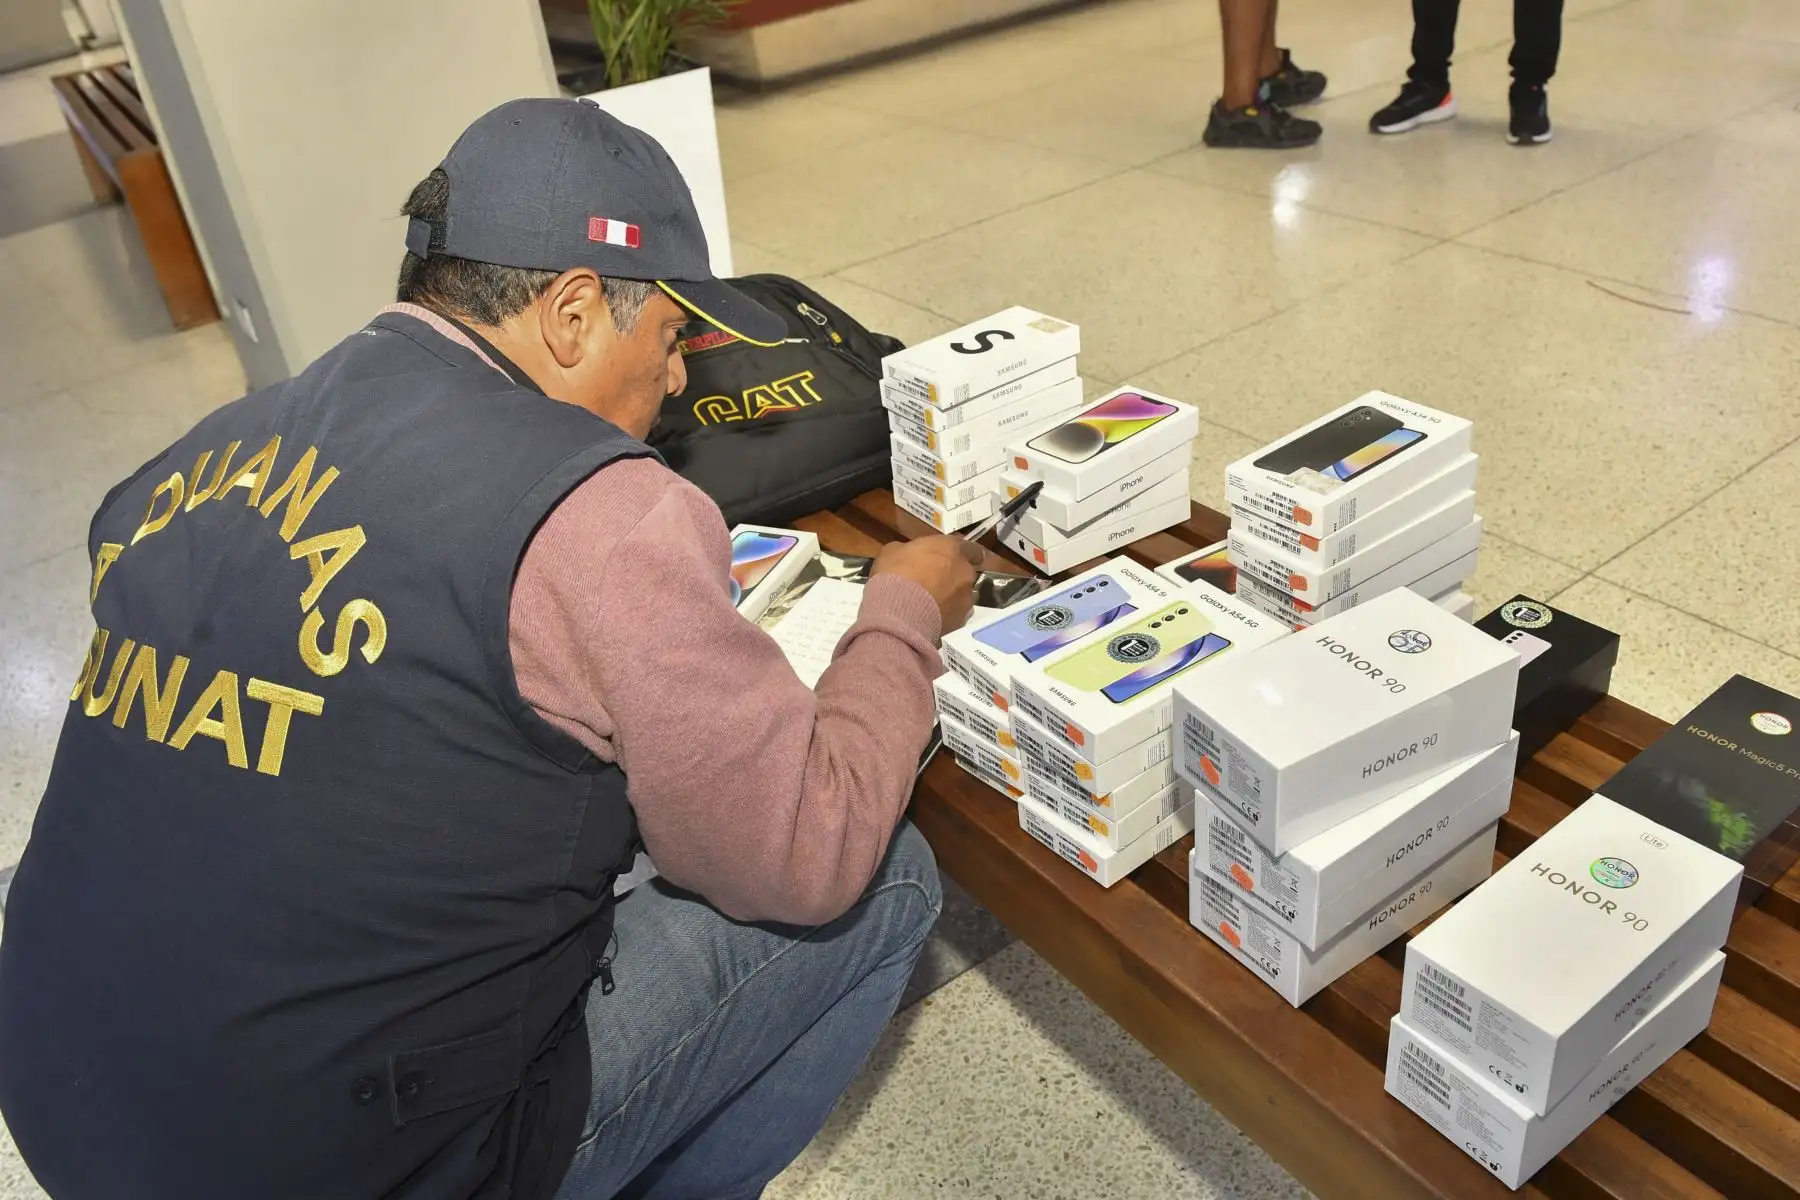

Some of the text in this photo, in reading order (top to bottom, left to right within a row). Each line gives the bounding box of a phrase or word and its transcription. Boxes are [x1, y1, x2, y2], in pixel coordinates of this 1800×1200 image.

[950, 330, 1015, 354] S
[997, 358, 1028, 377] SAMSUNG
[692, 370, 823, 427] CAT
[991, 383, 1023, 401] SAMSUNG
[997, 410, 1029, 427] SAMSUNG
[1119, 475, 1144, 493] iPhone
[1107, 526, 1135, 542] iPhone
[1120, 568, 1146, 586] Galaxy
[1199, 593, 1230, 615] Galaxy
[1227, 609, 1247, 622] A54
[1244, 619, 1260, 629] 5G
[974, 649, 998, 667] SAMSUNG
[1316, 636, 1407, 694] HONOR 90
[967, 691, 994, 708] SAMSUNG
[1048, 687, 1077, 707] SAMSUNG
[1759, 714, 1789, 730] HONOR
[1362, 732, 1438, 779] HONOR 90
[1686, 725, 1738, 751] HONOR
[1738, 747, 1786, 772] Magic5
[1385, 815, 1450, 868] HONOR 90
[1643, 834, 1664, 848] Lite
[1600, 860, 1636, 880] HONOR
[1369, 881, 1433, 930] HONOR 90
[1530, 862, 1649, 932] HONOR 90
[1614, 981, 1653, 1022] HONOR
[1588, 1063, 1629, 1103] HONOR
